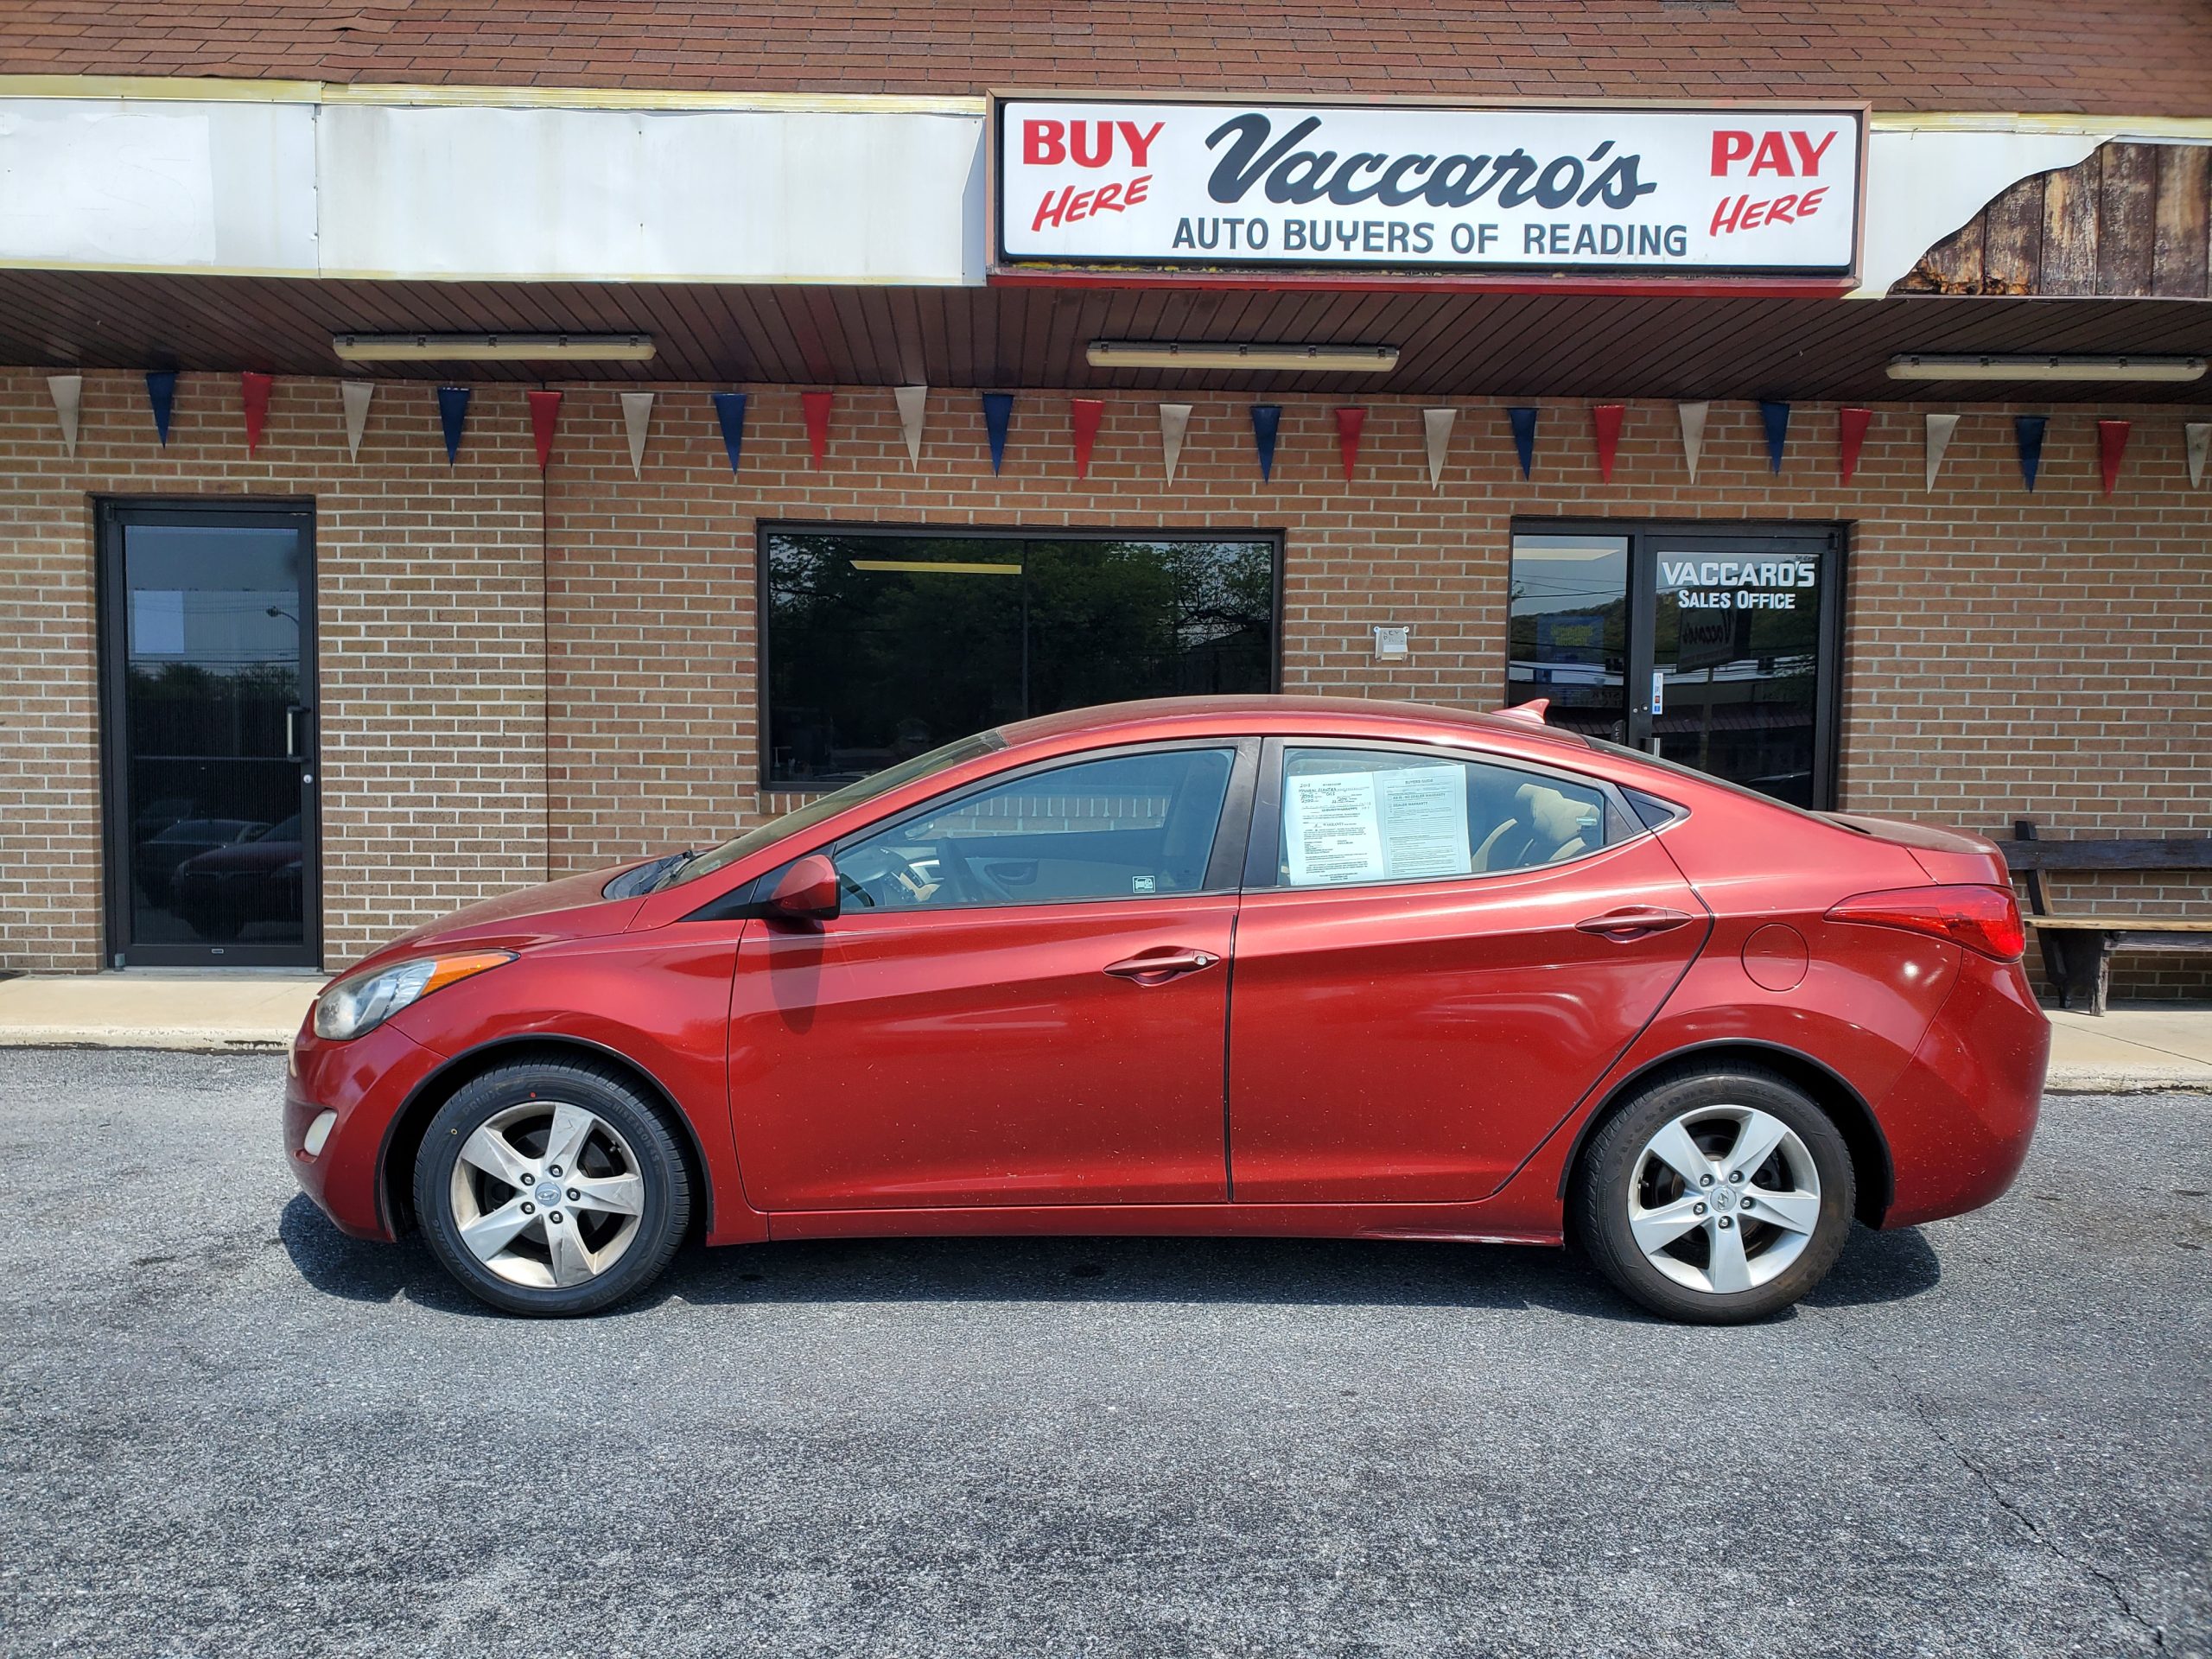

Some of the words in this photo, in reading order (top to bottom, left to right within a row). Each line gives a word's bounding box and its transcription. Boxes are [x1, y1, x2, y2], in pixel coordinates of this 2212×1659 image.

[1023, 119, 1166, 168] BUY
[1205, 112, 1657, 210] Vaccaro's
[1710, 130, 1839, 177] PAY
[1031, 175, 1153, 232] HERE
[1709, 186, 1830, 237] HERE
[1172, 217, 1268, 251] AUTO
[1283, 219, 1434, 253] BUYERS
[1451, 222, 1498, 255] OF
[1523, 223, 1687, 257] READING
[1662, 561, 1815, 588] VACCARO'S
[1678, 589, 1732, 608] SALES
[1737, 589, 1796, 609] OFFICE
